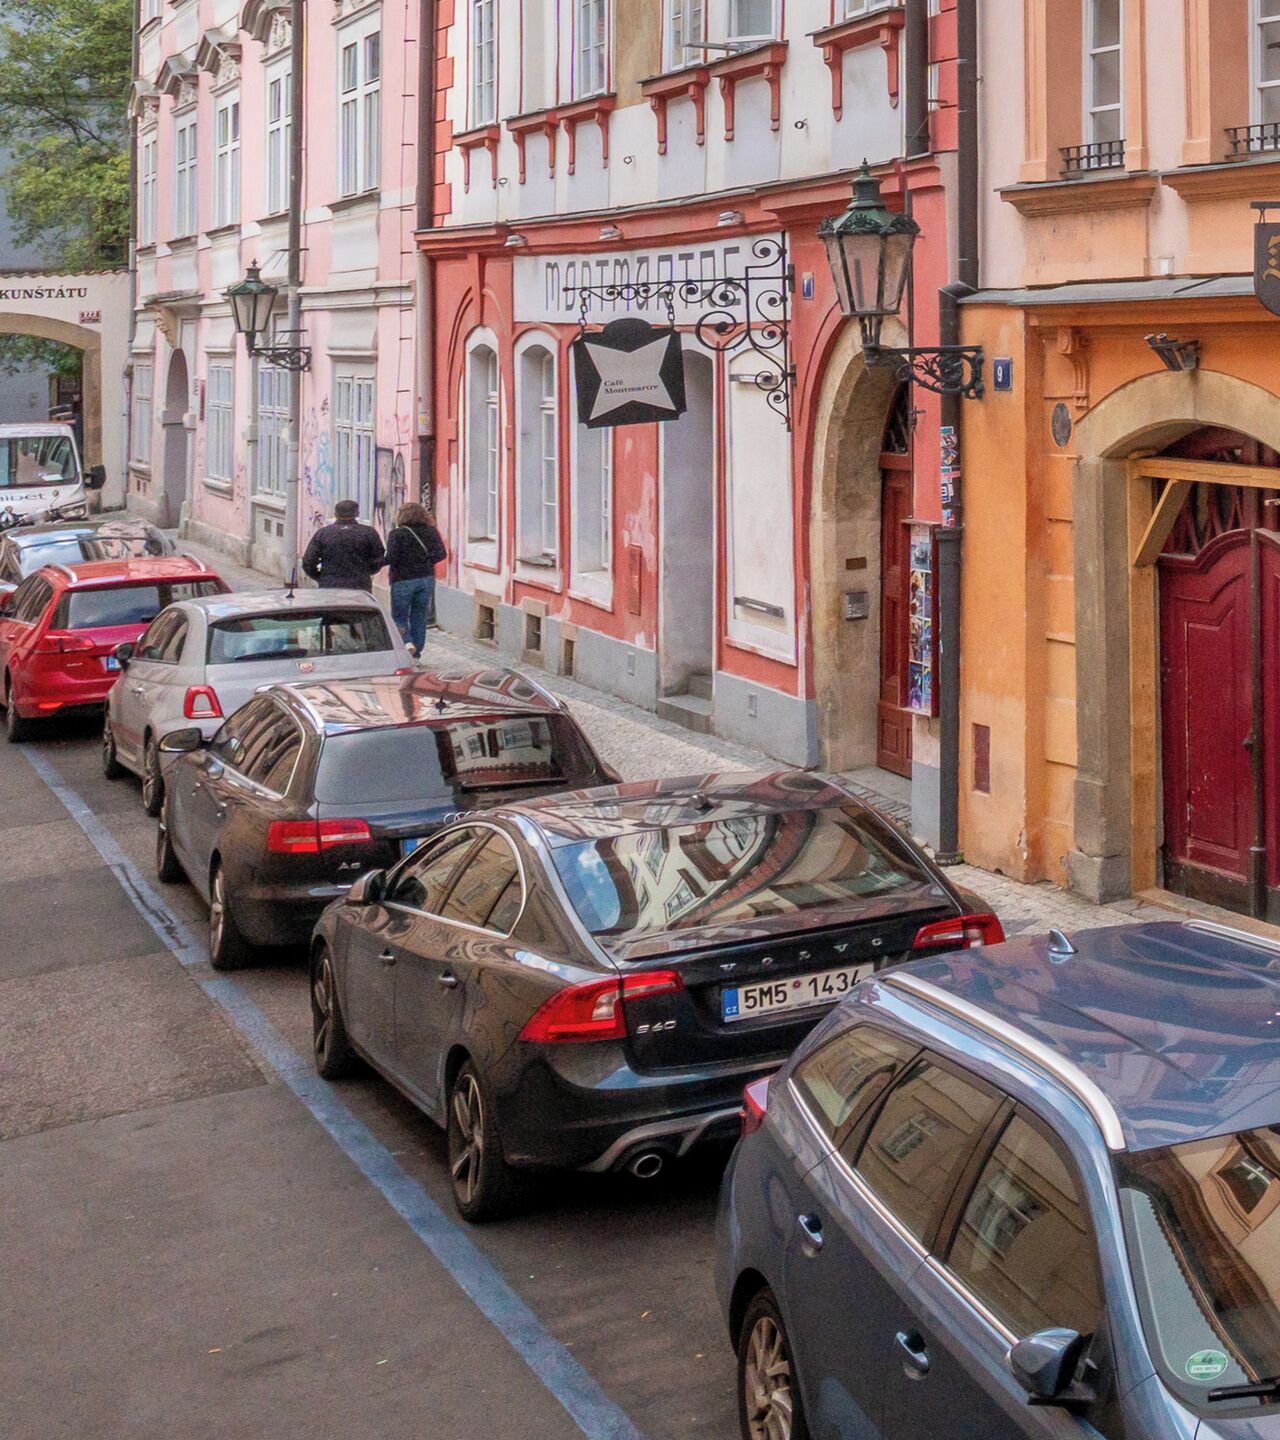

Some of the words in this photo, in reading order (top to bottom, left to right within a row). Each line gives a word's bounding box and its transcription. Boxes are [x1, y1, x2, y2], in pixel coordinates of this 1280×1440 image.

[0, 285, 88, 300] KUNŠTÁTU
[996, 365, 1004, 383] 9
[604, 384, 658, 395] Montmartre
[720, 937, 882, 971] VOLVO
[744, 983, 788, 1010] 5M5
[725, 1004, 738, 1014] CZ
[636, 1020, 677, 1035] S60
